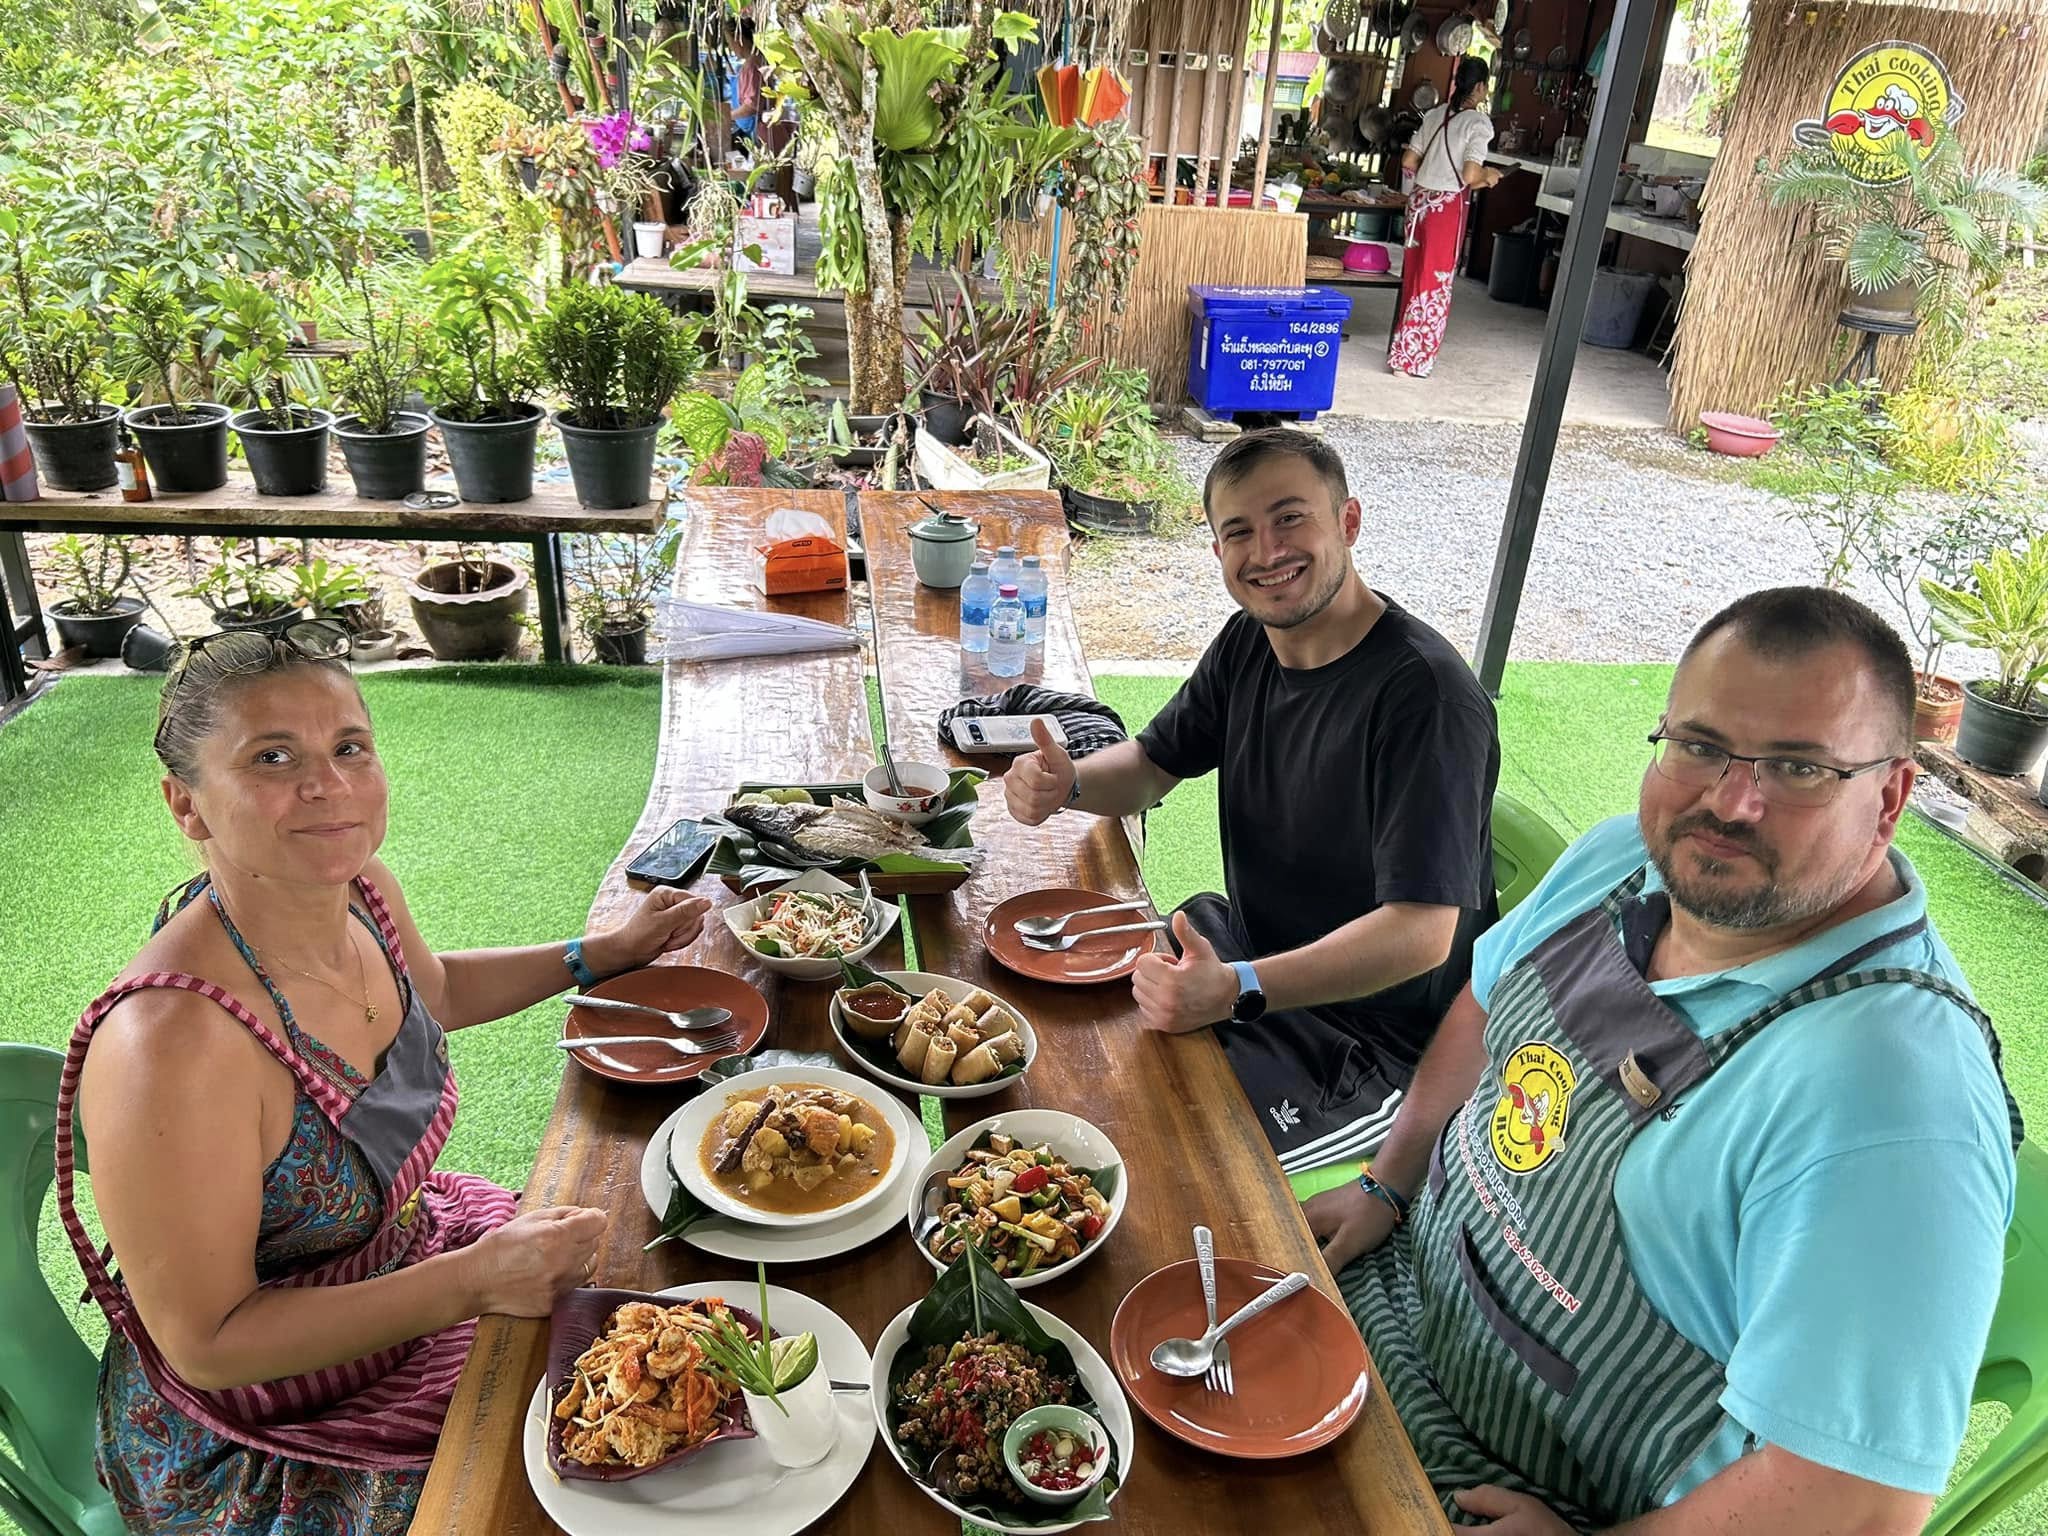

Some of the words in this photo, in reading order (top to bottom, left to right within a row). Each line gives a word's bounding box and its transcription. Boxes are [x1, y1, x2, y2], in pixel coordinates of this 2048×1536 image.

[1840, 57, 1881, 97] Thai
[1289, 322, 1340, 335] 164/2896
[1516, 1050, 1546, 1067] Thai
[1496, 1114, 1523, 1165] Home
